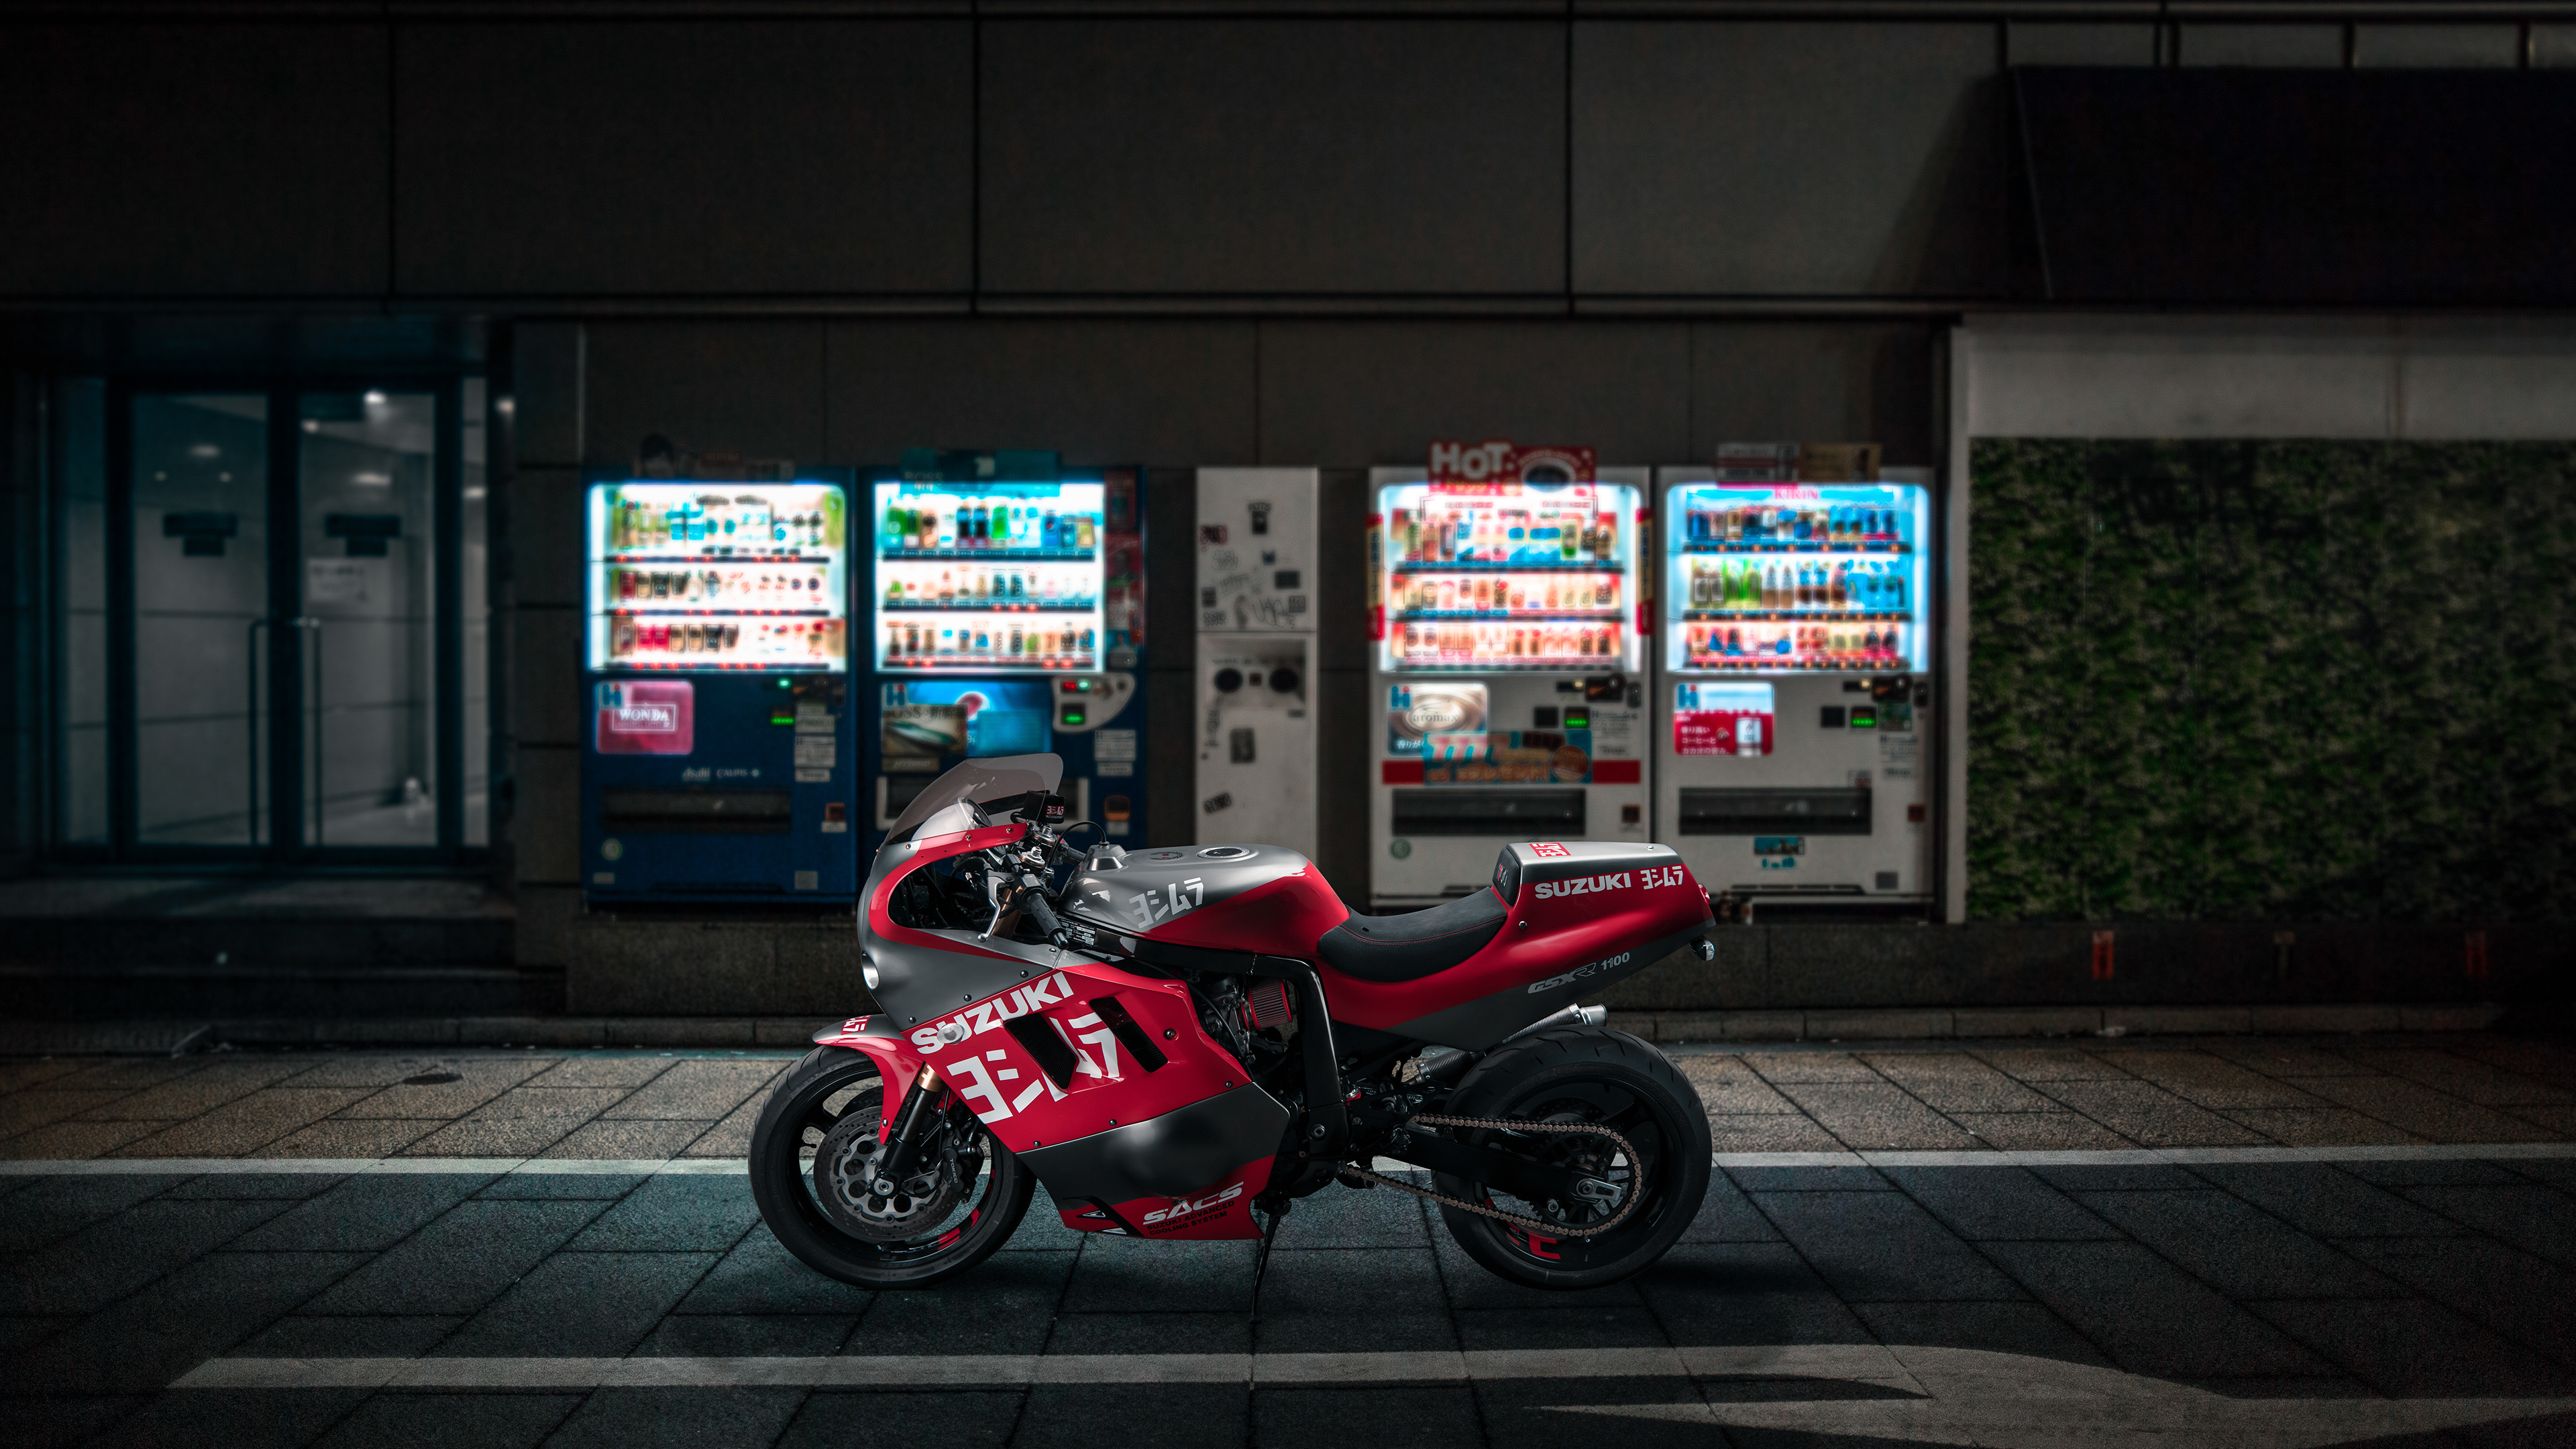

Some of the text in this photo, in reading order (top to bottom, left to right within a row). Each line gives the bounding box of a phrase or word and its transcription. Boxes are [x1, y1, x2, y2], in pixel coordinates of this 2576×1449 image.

[1774, 489, 1818, 499] KIRIN
[619, 709, 669, 721] WONDA
[1413, 714, 1458, 722] aromax
[894, 761, 930, 769] HYBRID
[1535, 866, 1684, 900] SUZUKI ヨシムラ
[1129, 877, 1204, 929] ヨシムラ
[1601, 952, 1630, 971] 1100
[911, 971, 1074, 1055] SUZUKI
[950, 1158, 958, 1183] TOKICO
[1143, 1181, 1244, 1225] SACS
[1146, 1200, 1234, 1230] SUZUKI ADVANCED
[1149, 1211, 1228, 1235] COOLING SYSTEM
